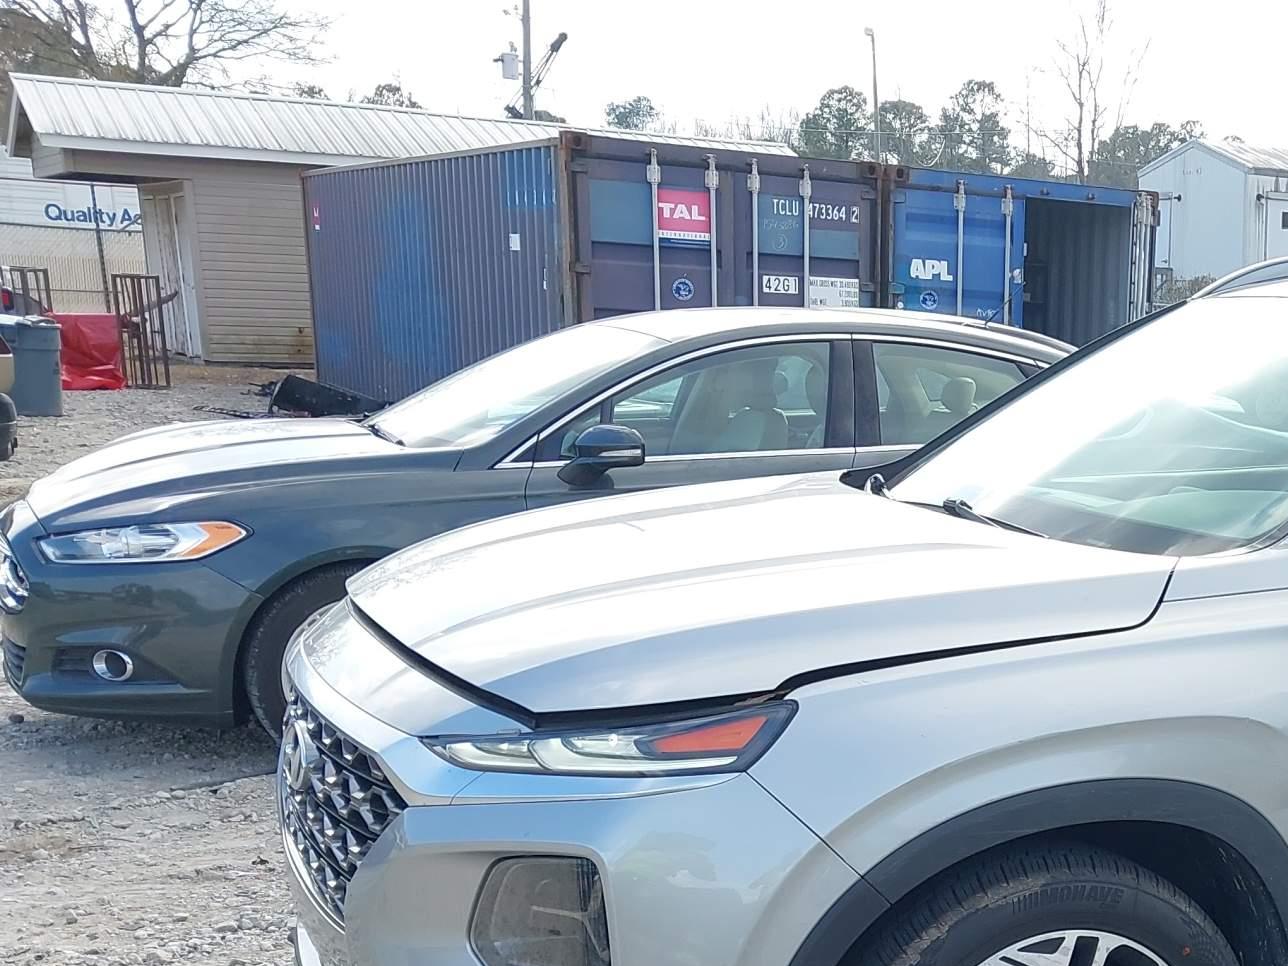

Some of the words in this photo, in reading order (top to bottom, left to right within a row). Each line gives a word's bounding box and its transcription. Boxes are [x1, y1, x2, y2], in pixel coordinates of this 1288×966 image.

[44, 203, 117, 227] Quality
[658, 202, 706, 221] TAL
[772, 199, 799, 216] TCLU
[808, 203, 846, 221] 473364
[851, 207, 859, 222] 2
[910, 258, 953, 281] APL
[764, 276, 797, 292] 42G1
